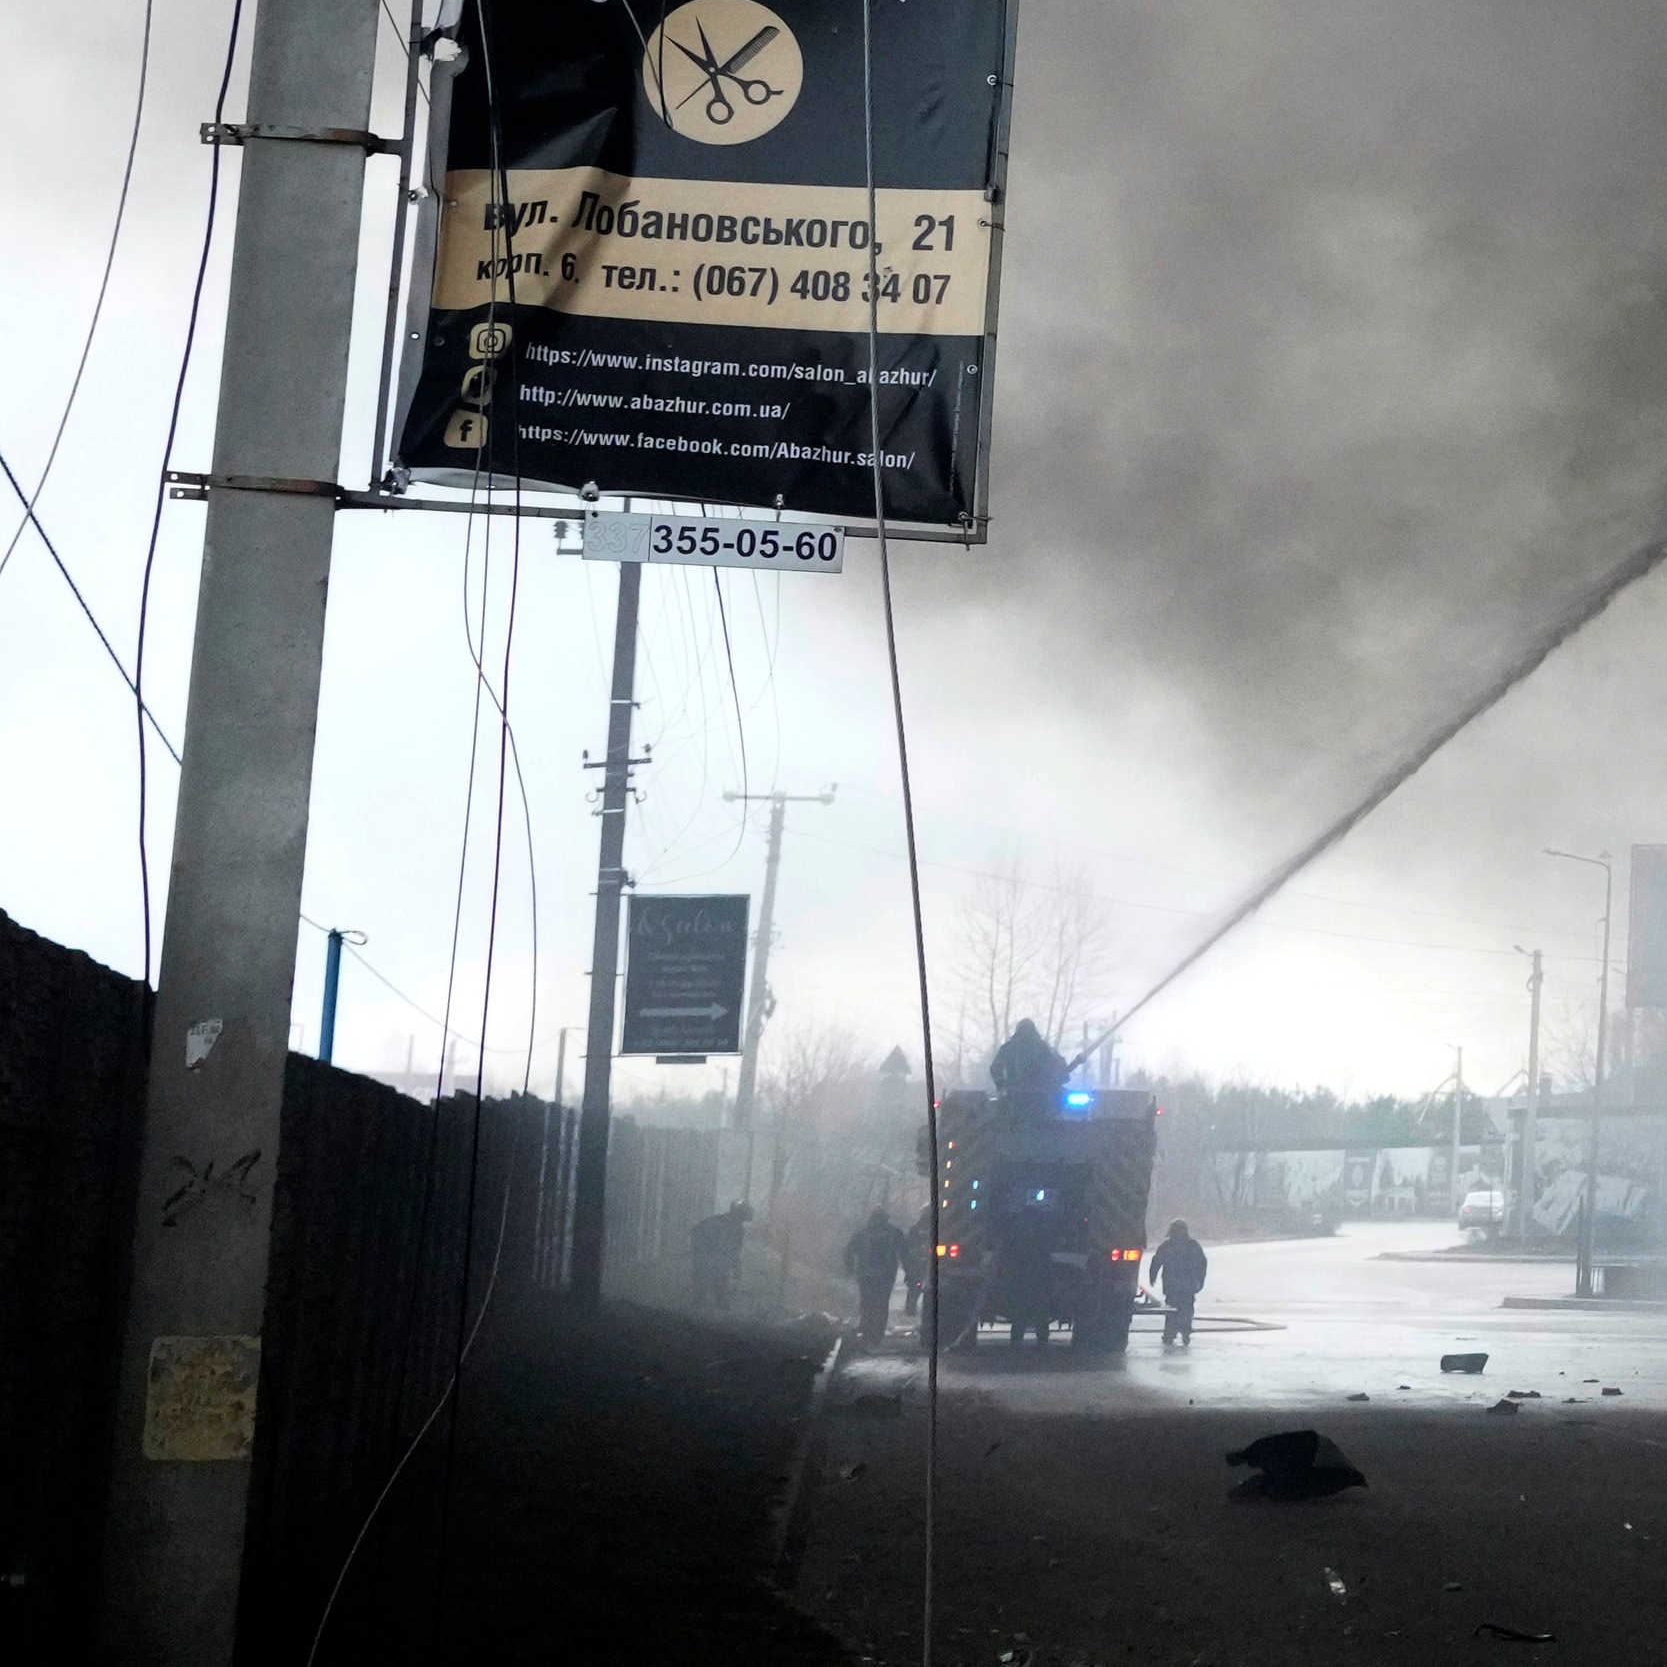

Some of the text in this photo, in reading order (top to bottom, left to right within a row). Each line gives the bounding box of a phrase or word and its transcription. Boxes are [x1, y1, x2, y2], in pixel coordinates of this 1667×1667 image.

[484, 190, 955, 256] вул. Лобановського, 21
[601, 264, 681, 293] тел.:
[693, 263, 779, 306] (067)
[791, 269, 851, 302] 408
[861, 272, 901, 304] 34
[912, 273, 951, 305] 07
[519, 384, 791, 420] http://www.abazhur.com.ua/
[518, 424, 916, 470] https://www.facebook.com/Abazhur.salon/
[652, 524, 838, 562] 355-05-60
